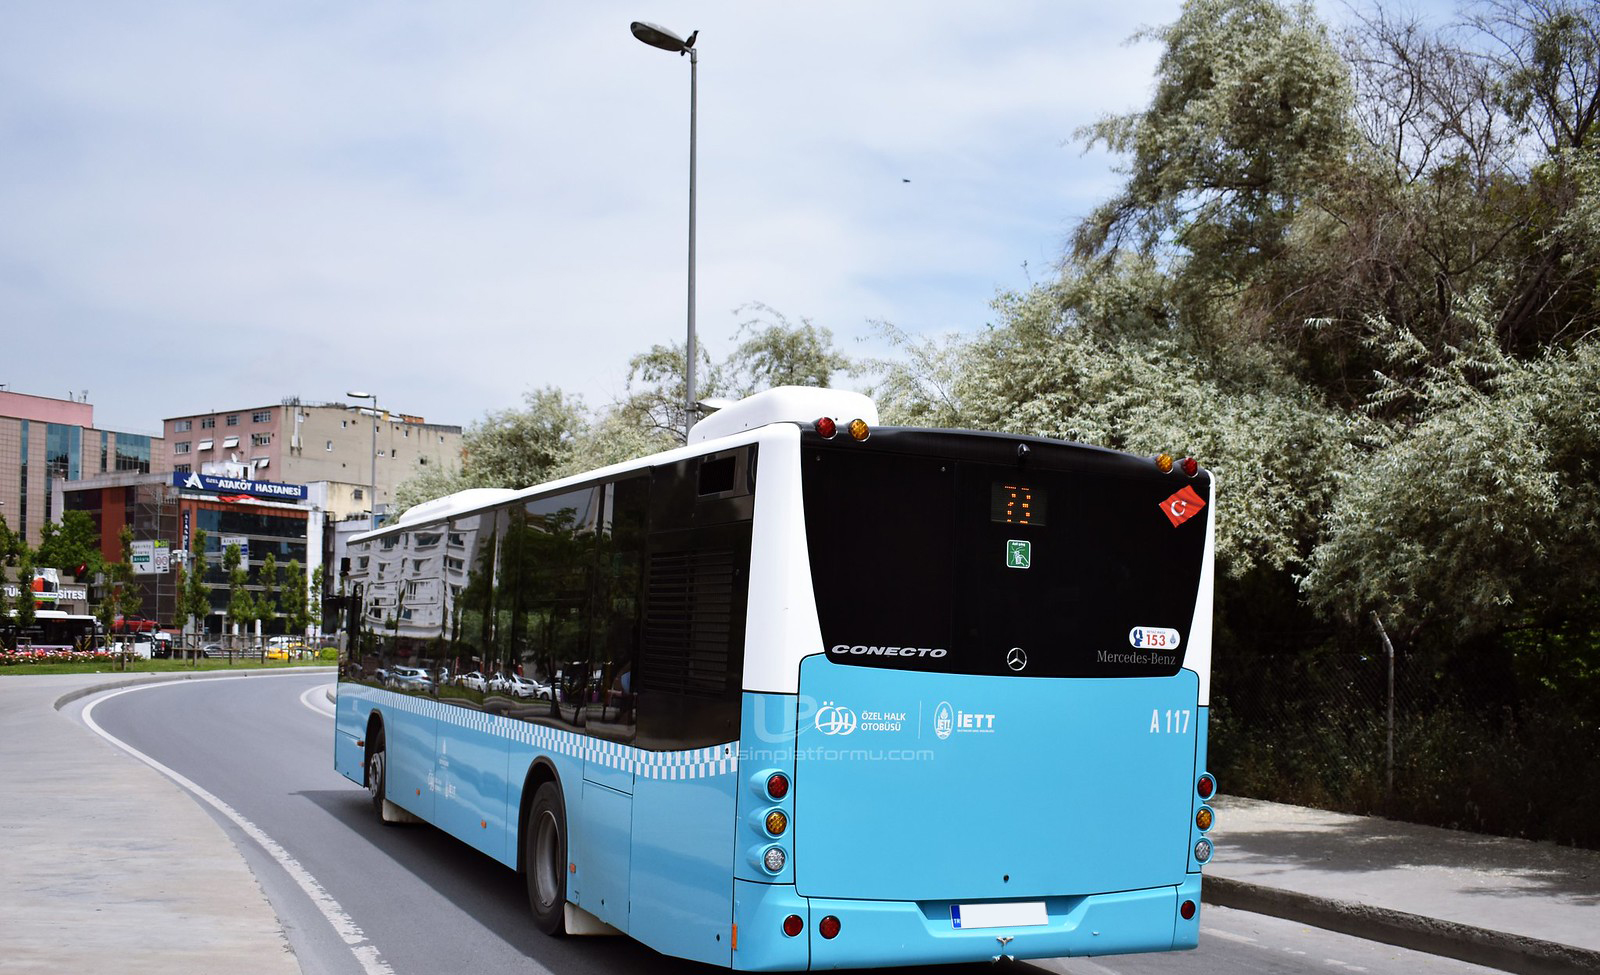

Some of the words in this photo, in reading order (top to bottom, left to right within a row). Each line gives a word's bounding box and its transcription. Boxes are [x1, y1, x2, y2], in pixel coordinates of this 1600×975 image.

[218, 479, 252, 491] ATAKÖY
[255, 484, 302, 496] HASTANESİ
[58, 587, 86, 600] SİTESİ
[1146, 634, 1166, 647] 153
[831, 644, 948, 658] CONECTO
[1096, 649, 1177, 665] Mercedes-Benz
[861, 710, 883, 721] ÖZEL
[884, 712, 906, 721] HALK
[957, 710, 996, 728] İETT
[1150, 709, 1160, 733] A
[1165, 709, 1191, 734] 117
[861, 721, 901, 732] OTOBÜSÜ
